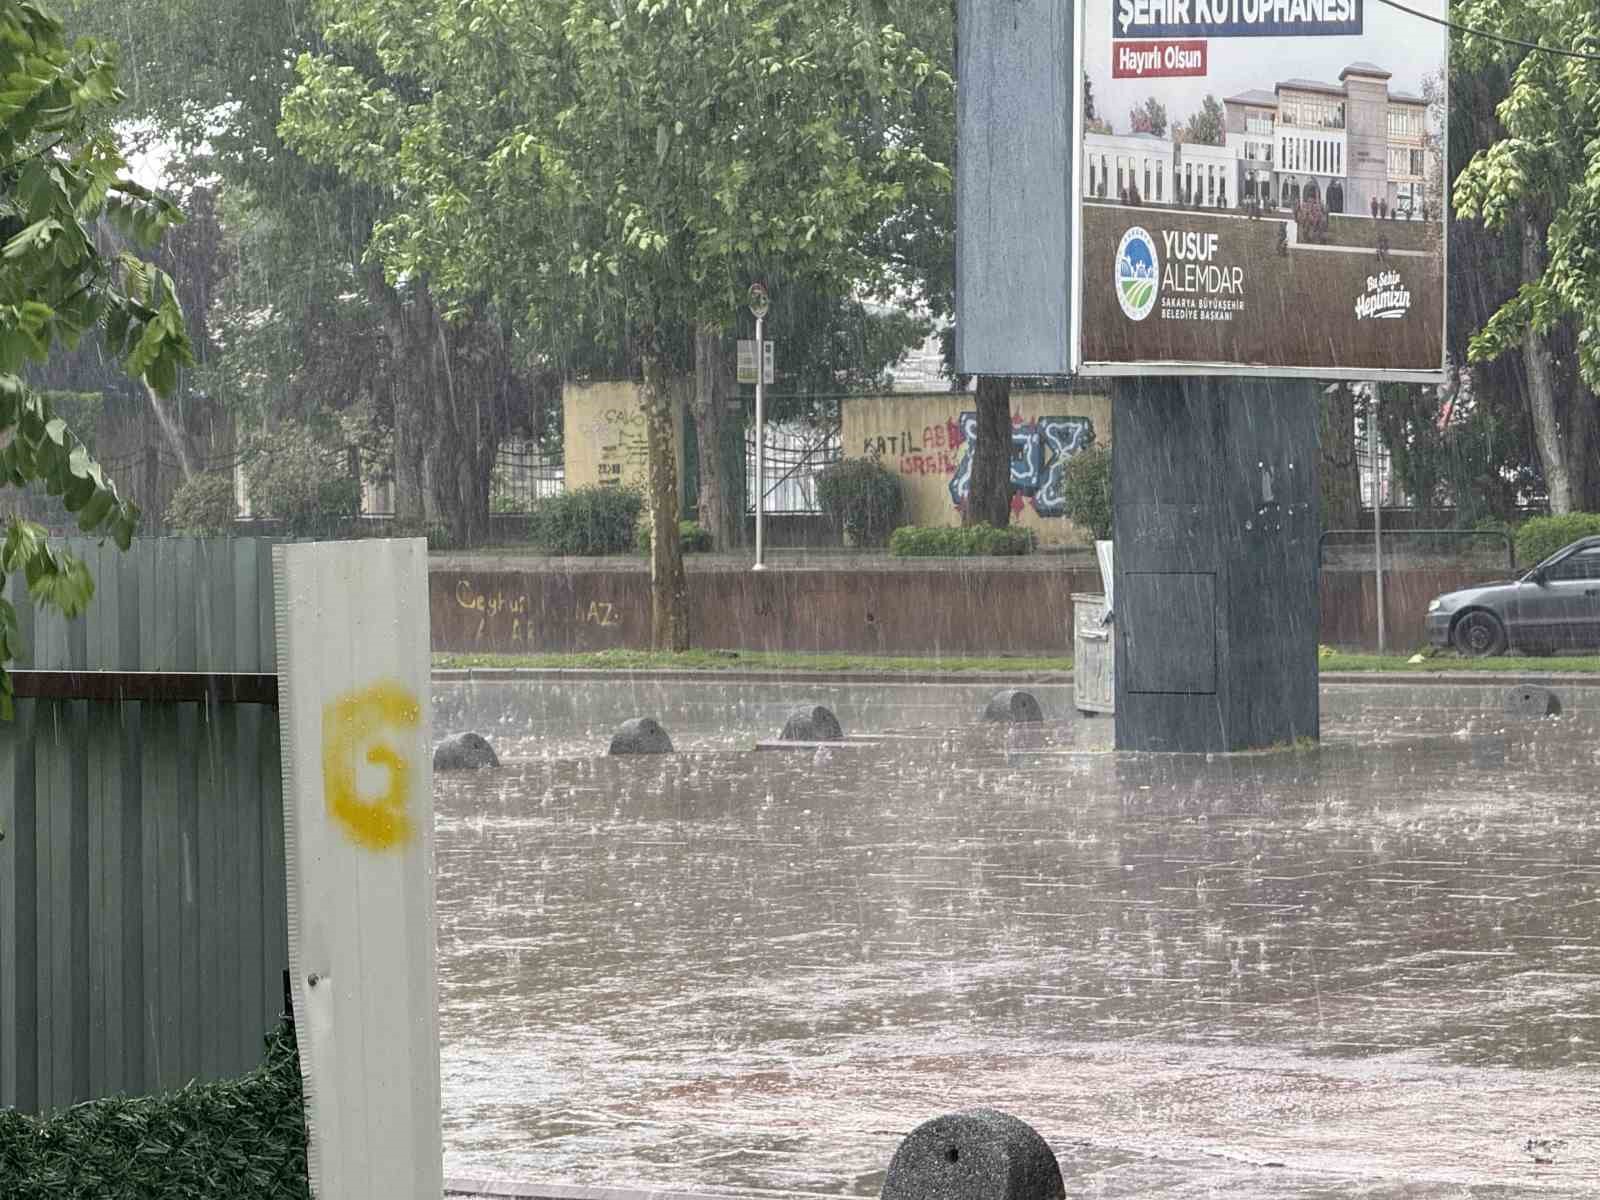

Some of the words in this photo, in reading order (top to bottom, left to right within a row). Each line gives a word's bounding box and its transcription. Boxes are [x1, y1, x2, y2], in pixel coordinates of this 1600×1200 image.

[1119, 45, 1161, 74] Hayırlı
[1164, 46, 1202, 69] Olsun
[1161, 230, 1219, 261] YUSUF
[1161, 264, 1244, 294] ALEMDAR
[1161, 297, 1196, 308] SAKARYA
